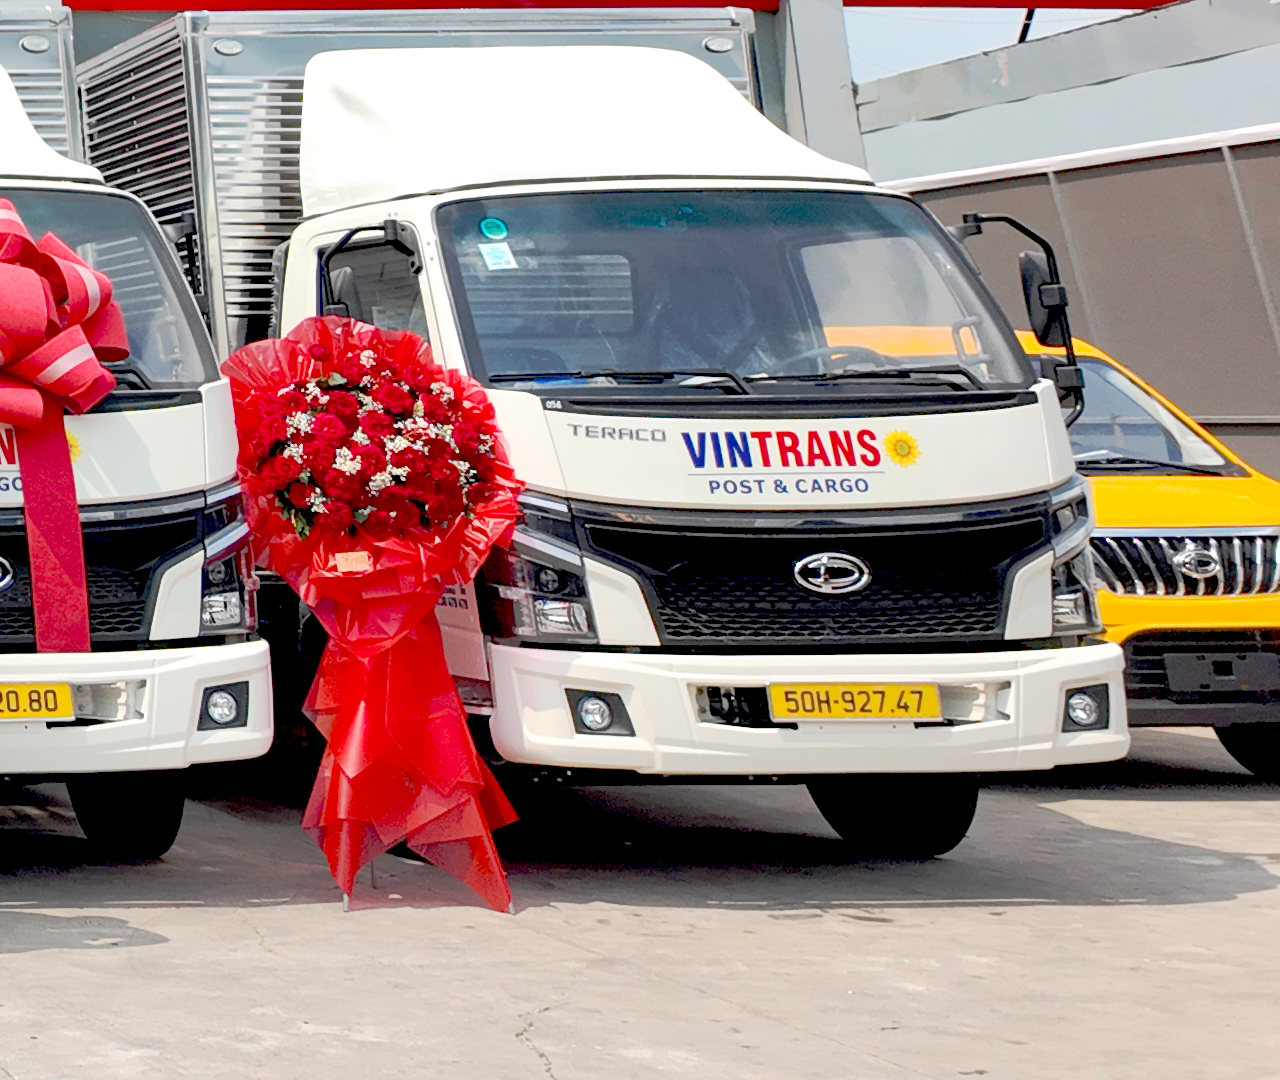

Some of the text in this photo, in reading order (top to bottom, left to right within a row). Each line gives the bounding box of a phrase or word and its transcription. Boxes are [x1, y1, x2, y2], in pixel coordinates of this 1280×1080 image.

[567, 423, 666, 442] TERACO
[681, 429, 882, 469] VINTRANS
[709, 478, 869, 495] POST & CARGO
[783, 690, 924, 713] 50H-927.47
